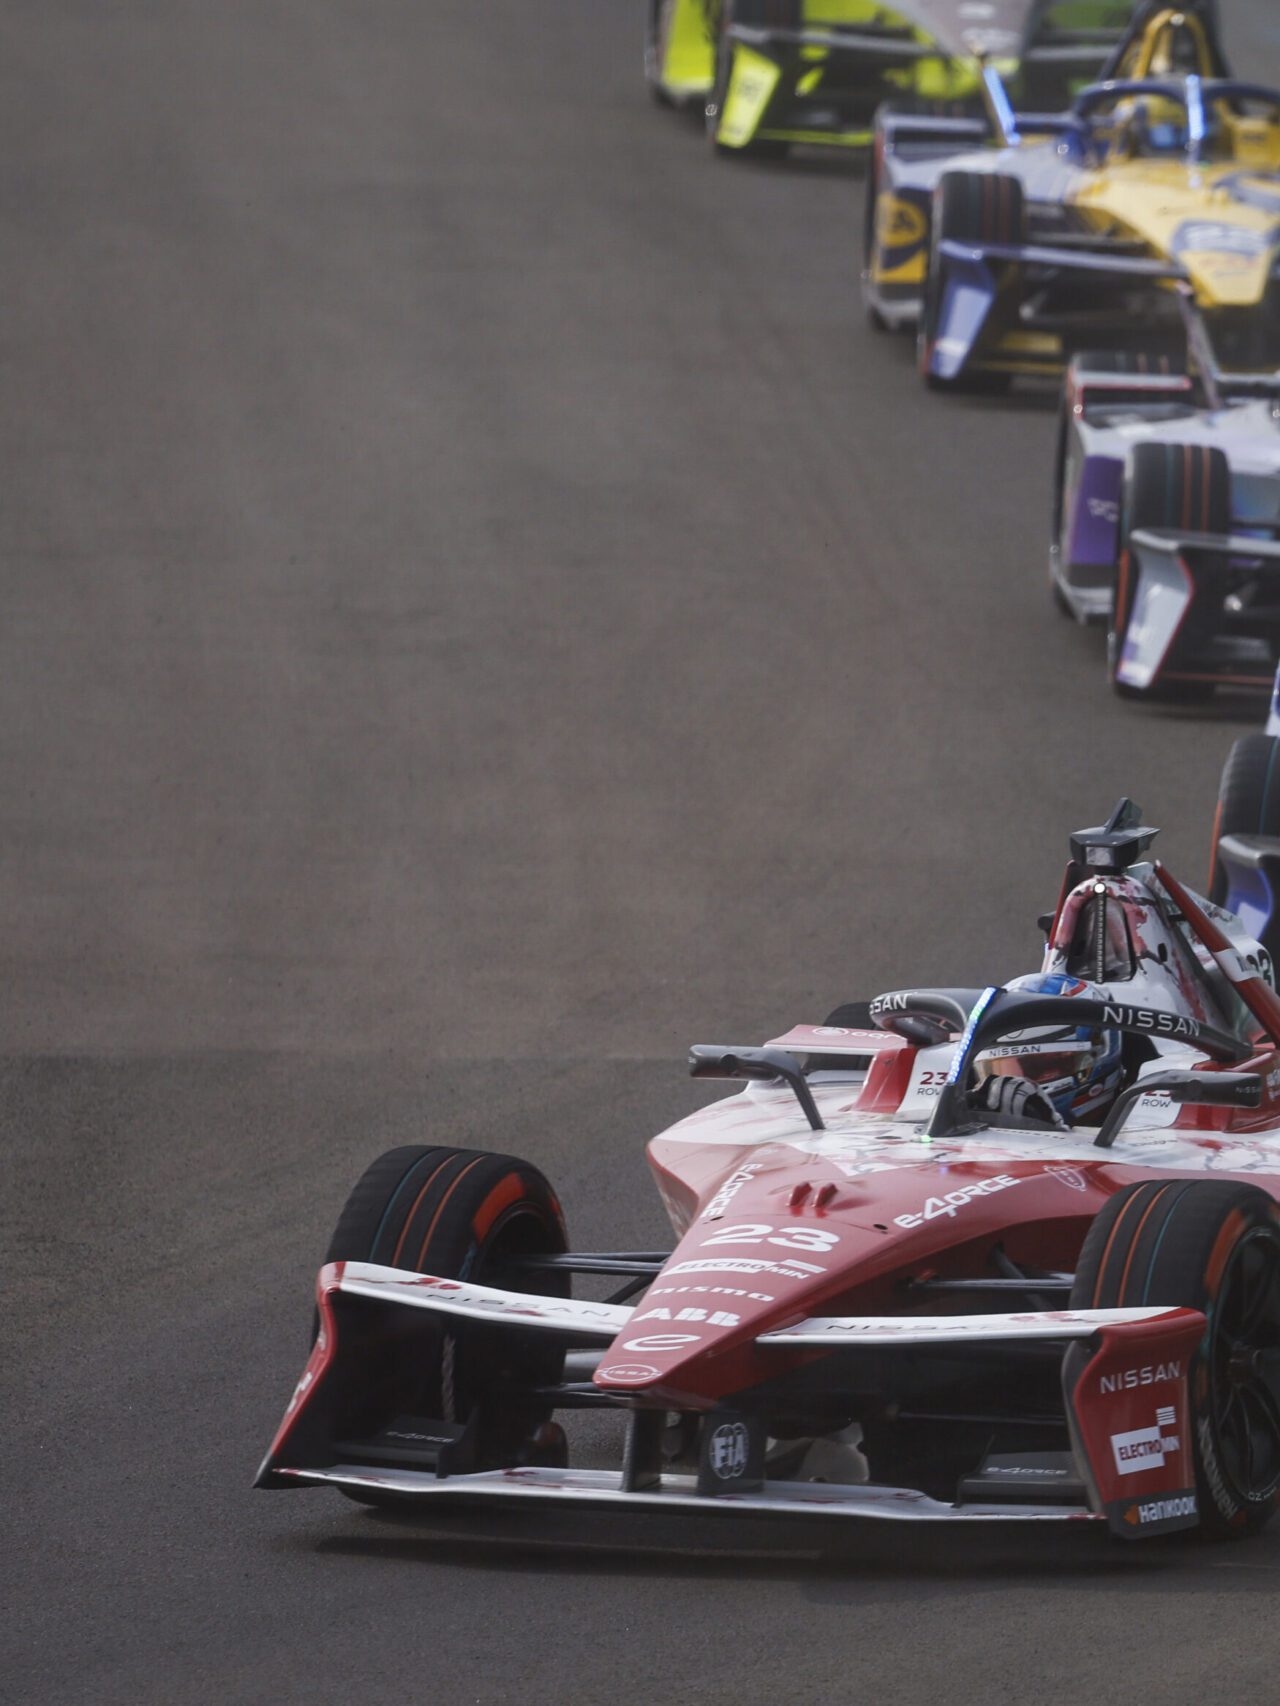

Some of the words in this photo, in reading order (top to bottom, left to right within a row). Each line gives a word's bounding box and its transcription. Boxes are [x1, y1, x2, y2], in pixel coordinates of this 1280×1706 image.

[1102, 1006, 1200, 1037] NISSAN
[989, 1045, 1041, 1058] NISSAN
[920, 1071, 950, 1085] 23
[700, 1224, 840, 1252] 23
[632, 1307, 742, 1327] ABB
[1100, 1361, 1181, 1394] NISSAN
